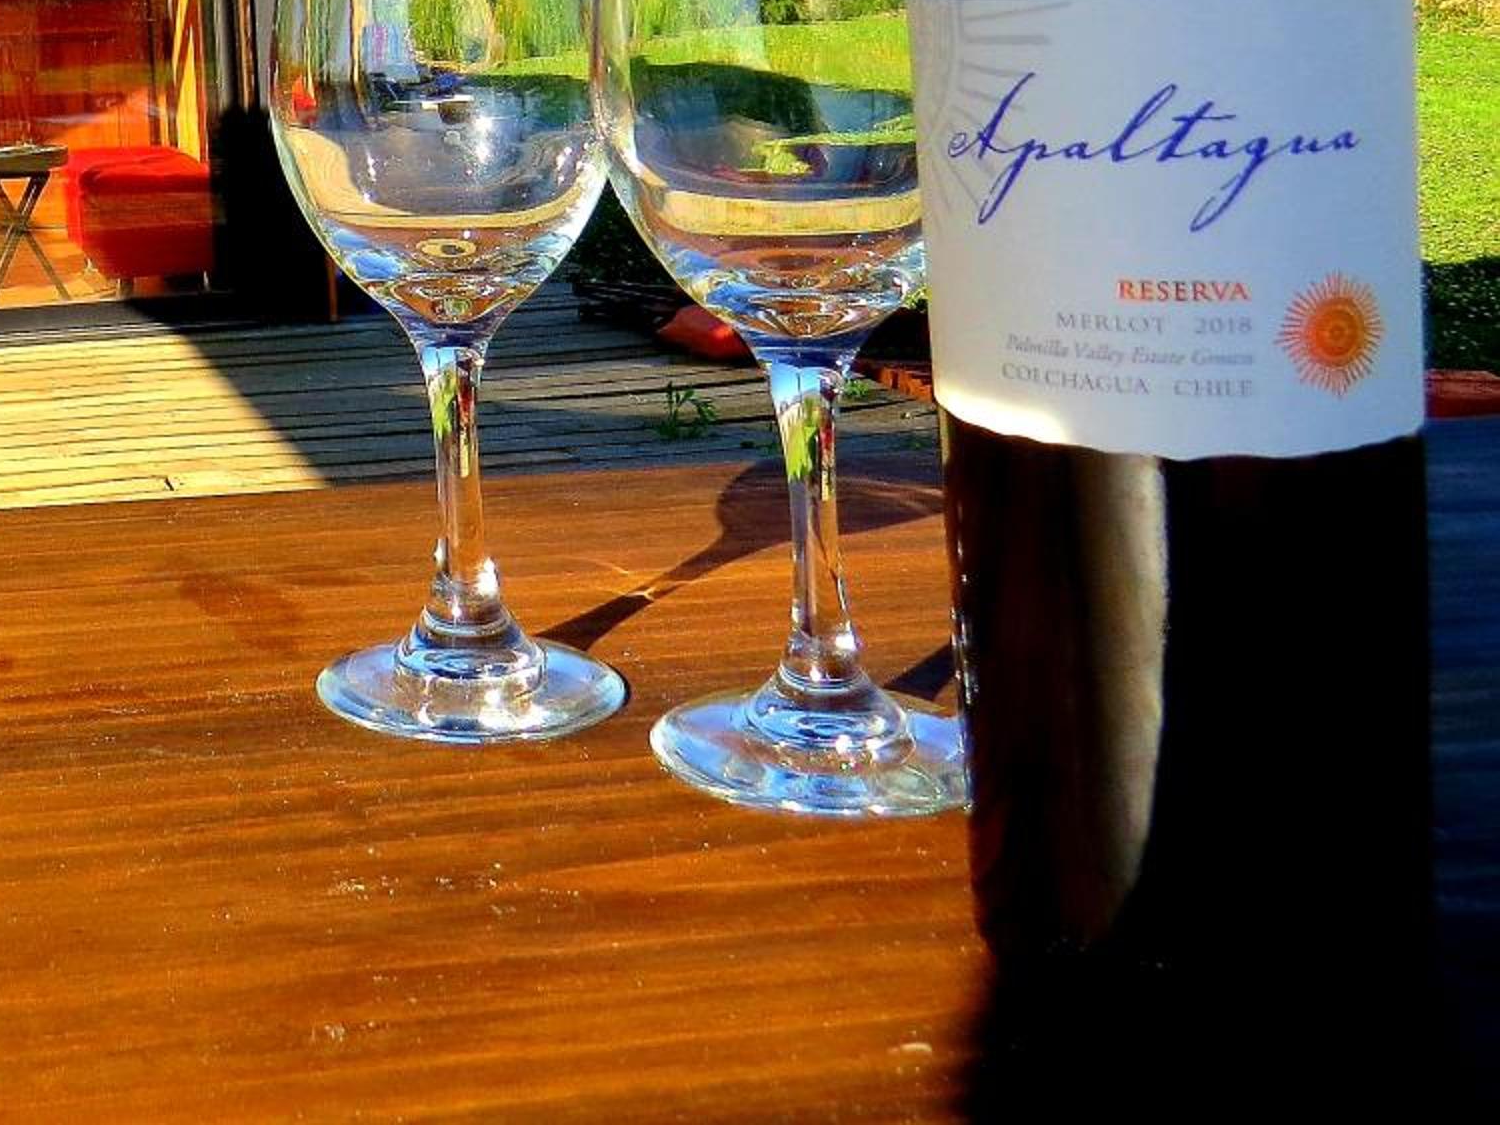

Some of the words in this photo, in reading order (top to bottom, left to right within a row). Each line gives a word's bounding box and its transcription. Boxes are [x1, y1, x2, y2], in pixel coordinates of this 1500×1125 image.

[947, 72, 1362, 233] Apaltagua
[1116, 279, 1252, 303] RESERVA
[1056, 311, 1166, 335] MERLOT
[1193, 316, 1253, 335] 2018
[1073, 341, 1125, 366] Valley
[1001, 363, 1151, 395] COLCHAGUA
[1173, 378, 1253, 397] CHILE
